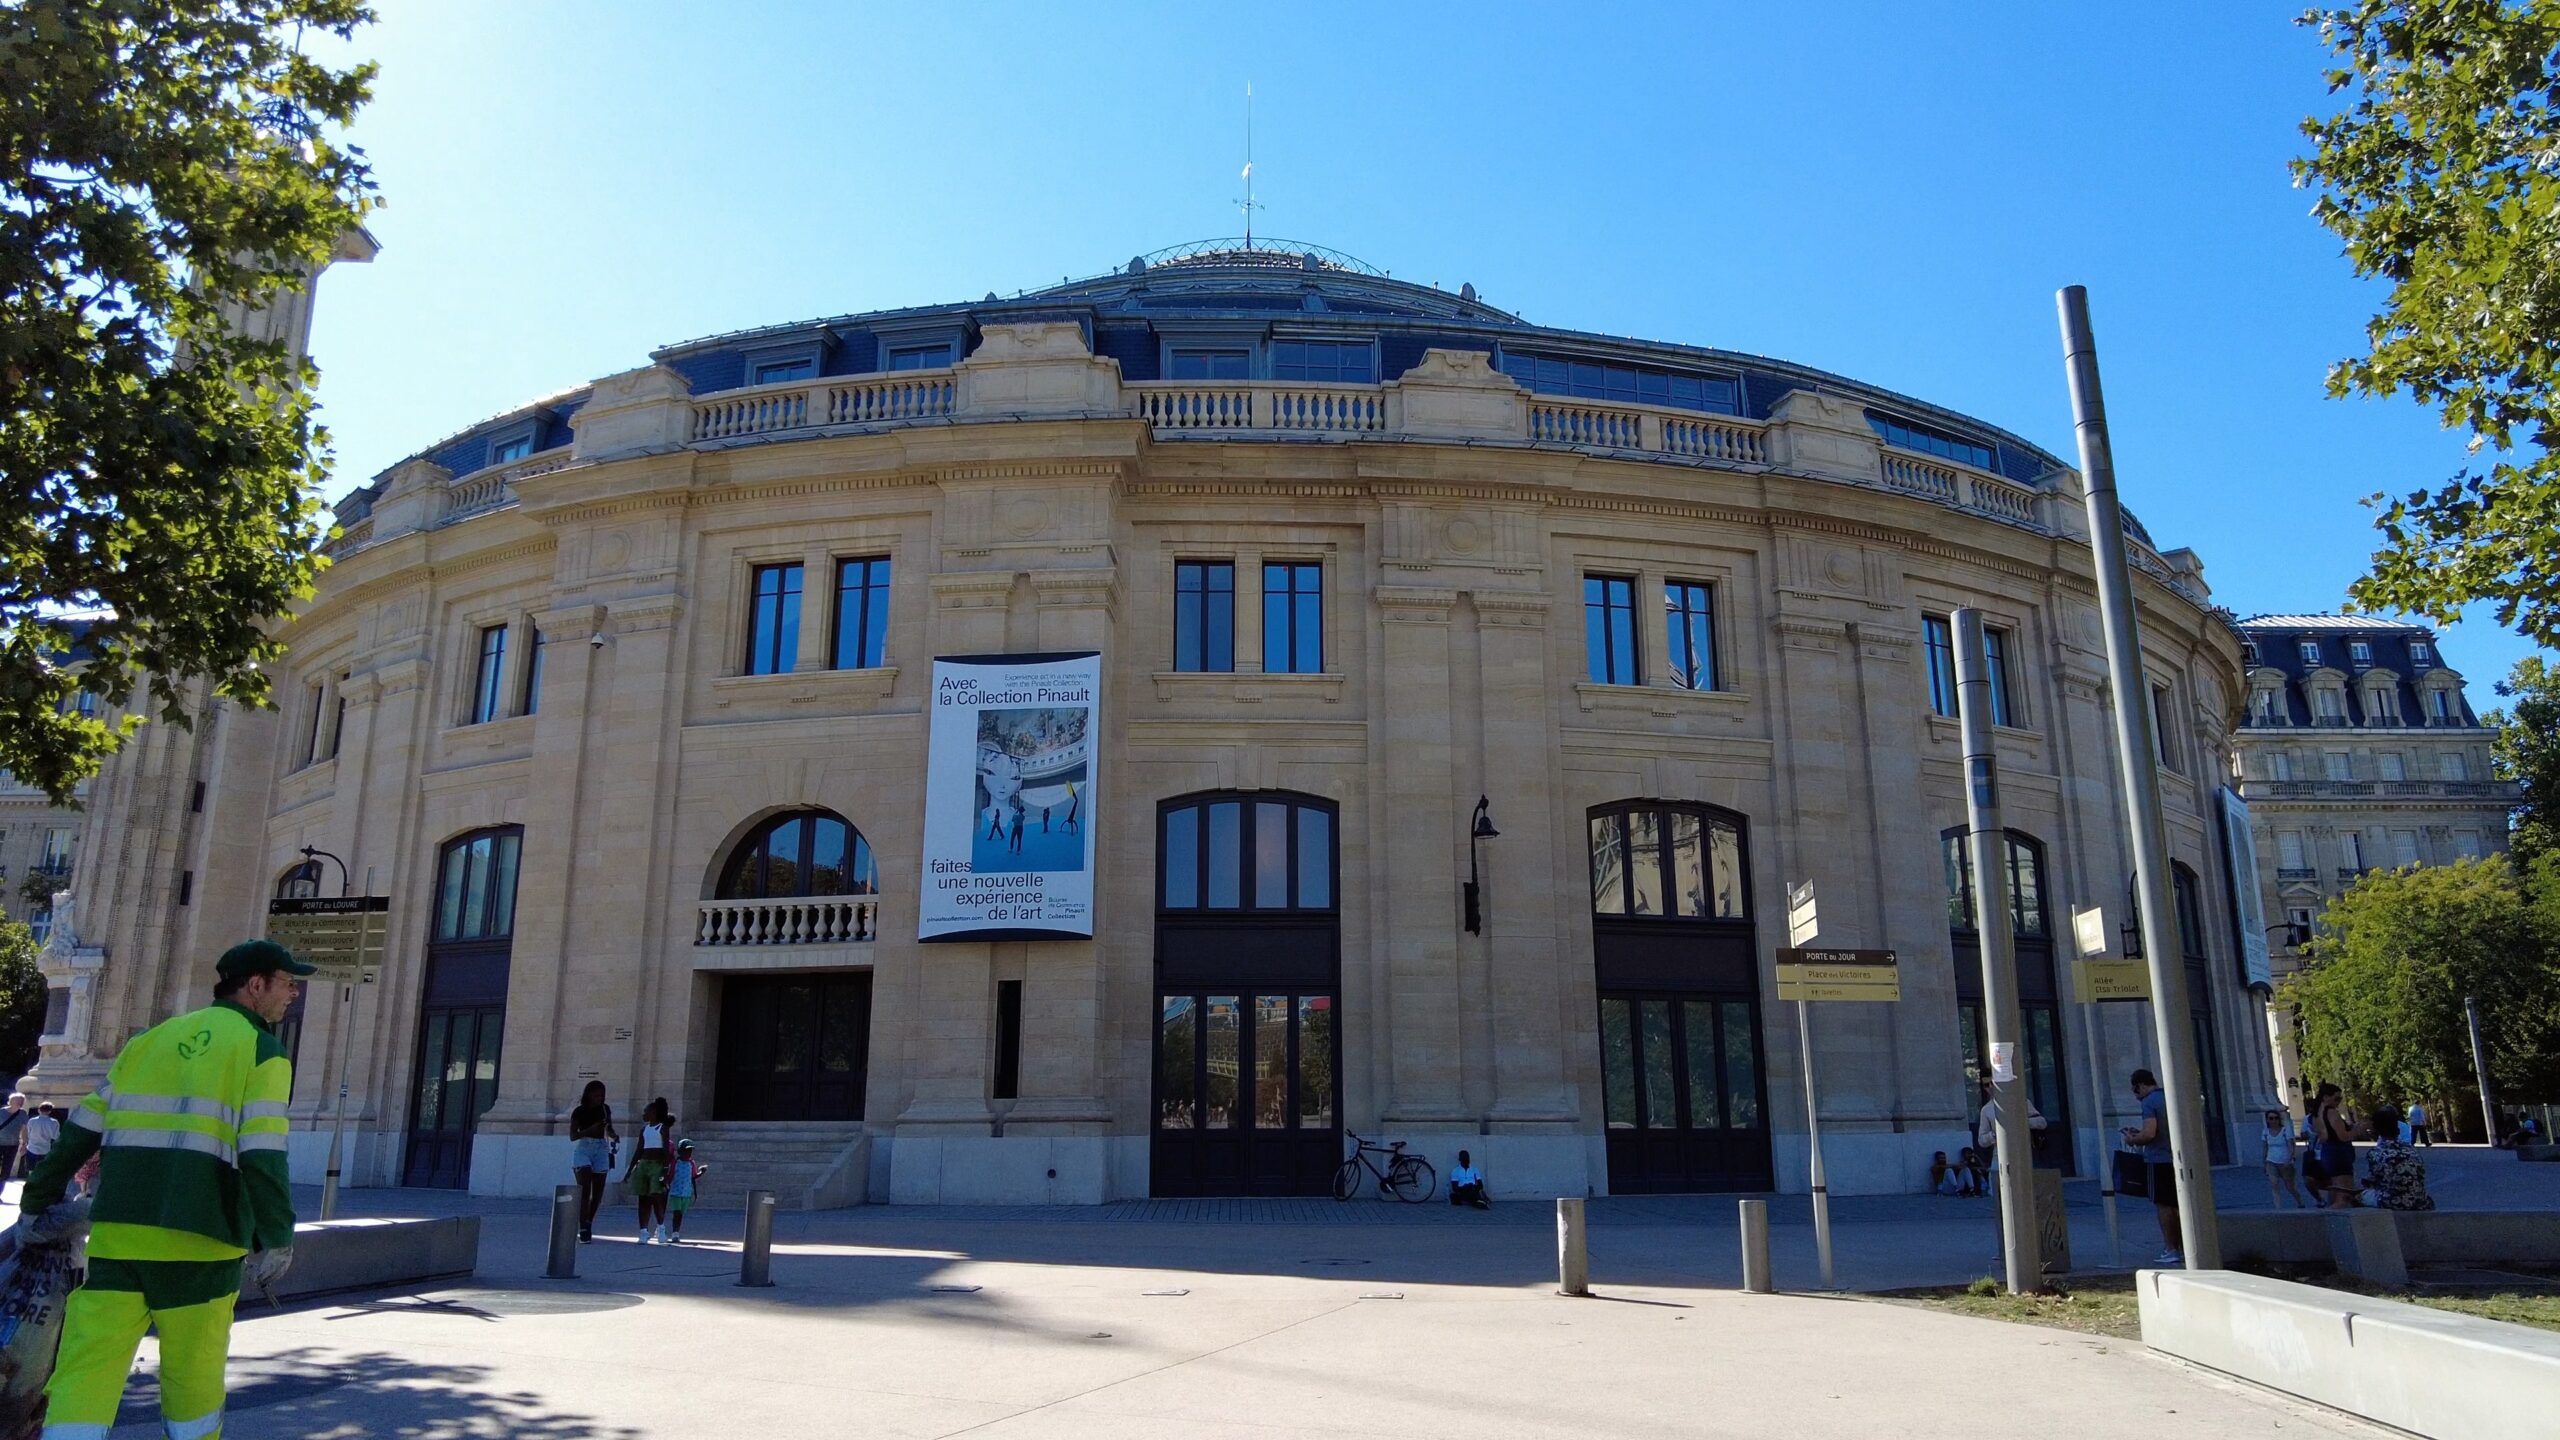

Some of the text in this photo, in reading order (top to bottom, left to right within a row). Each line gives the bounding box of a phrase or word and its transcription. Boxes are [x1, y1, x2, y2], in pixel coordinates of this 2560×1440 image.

[940, 676, 978, 690] Avec
[1053, 679, 1083, 687] Collection
[939, 687, 1090, 706] la Collection Pinault
[930, 858, 972, 873] faites
[938, 872, 1044, 889] une nouvelle
[302, 901, 322, 909] PORTE
[333, 901, 358, 909] LOUVRE
[956, 889, 1042, 908] expérience
[987, 904, 1042, 920] de l'art
[1806, 952, 1828, 961] PORTE
[1838, 953, 1856, 961] JOUR
[1808, 970, 1828, 978] Place
[1839, 970, 1871, 979] Victoires
[2113, 985, 2140, 993] Triolet
